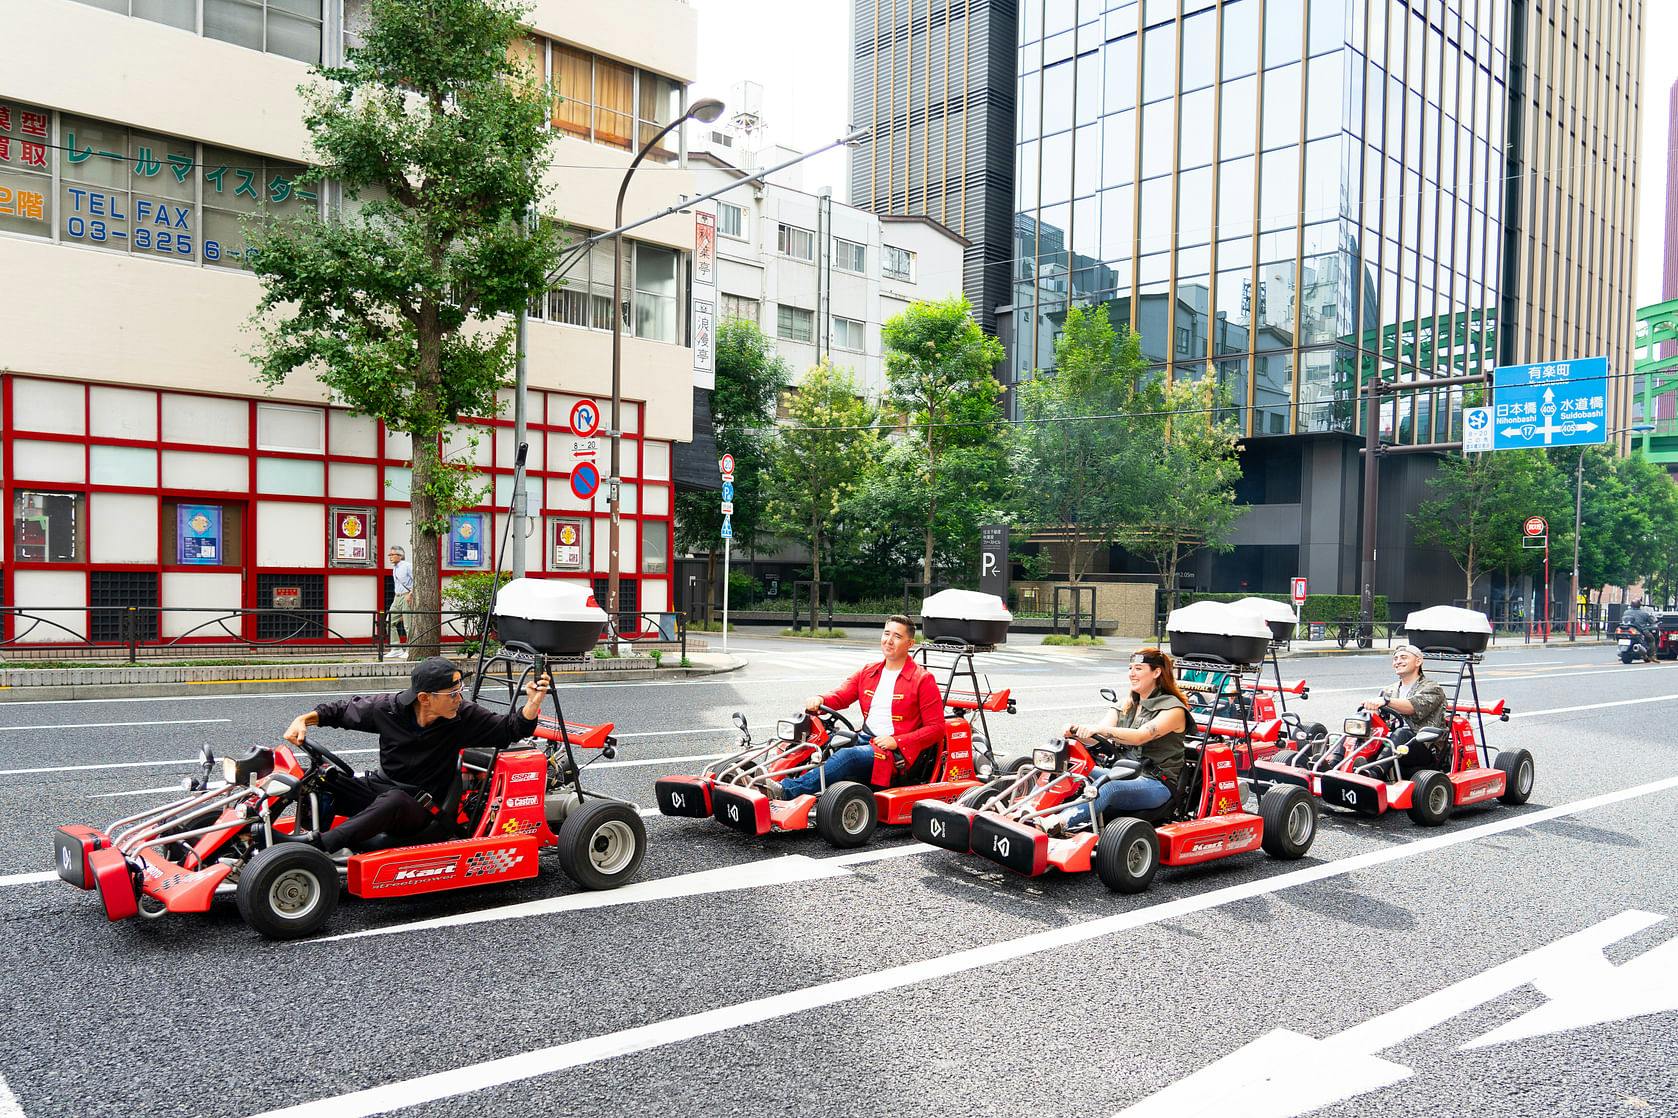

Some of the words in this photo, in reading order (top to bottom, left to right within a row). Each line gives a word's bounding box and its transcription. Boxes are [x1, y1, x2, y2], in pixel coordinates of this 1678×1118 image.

[66, 128, 317, 204] レールマイスター
[67, 188, 126, 220] TEL
[136, 200, 190, 230] FAX
[1528, 363, 1570, 379] 有楽町
[1496, 401, 1537, 417] 日本橋
[1542, 404, 1554, 413] 405
[1560, 396, 1604, 411] 水道橋
[1496, 415, 1537, 425] Nihonbashi
[1560, 410, 1603, 420] Suidobashi
[1523, 426, 1533, 436] 17
[982, 552, 996, 577] P
[514, 795, 539, 806] Castrol
[1192, 841, 1224, 852] Kart
[396, 864, 456, 880] Kart
[372, 874, 456, 889] streetpower
